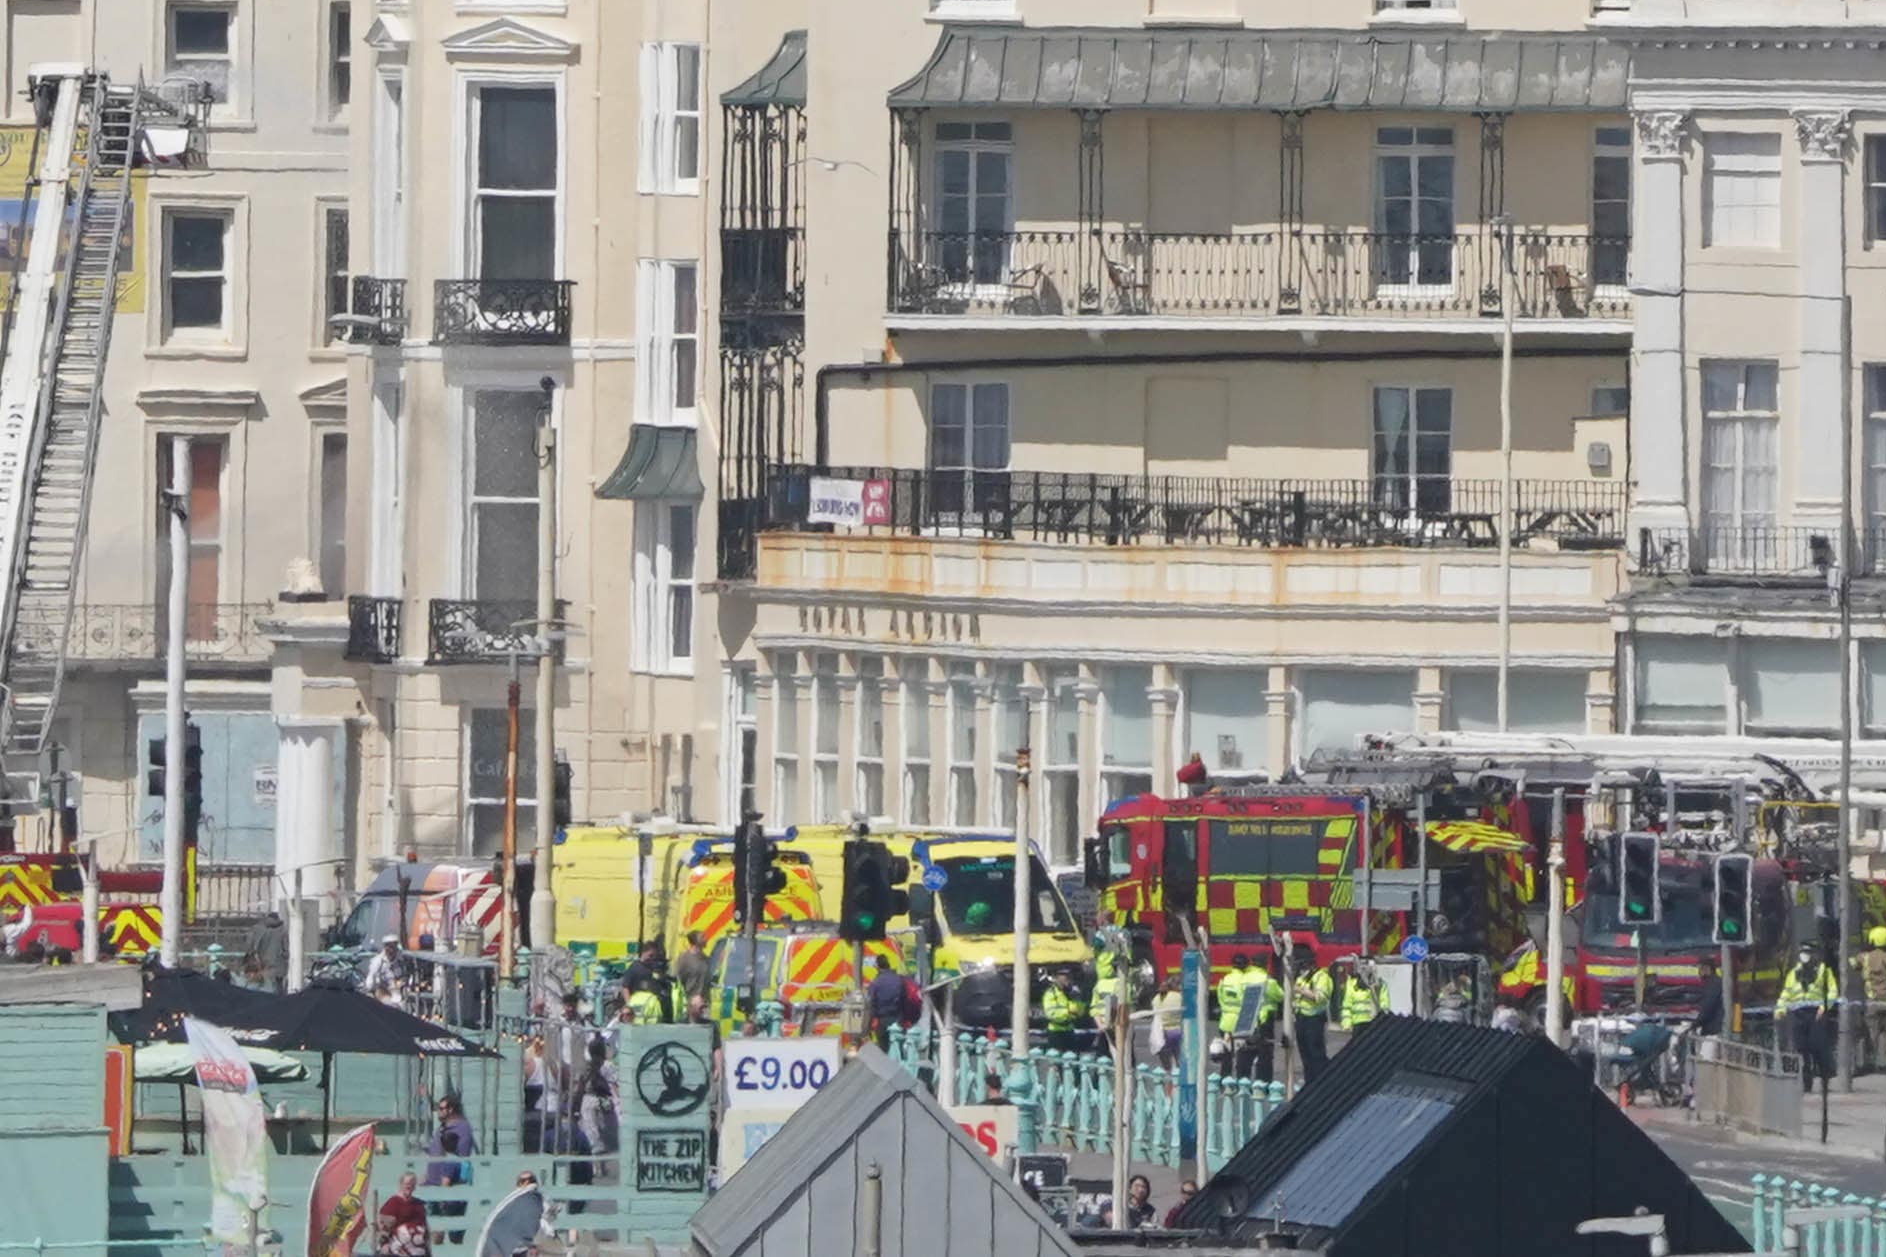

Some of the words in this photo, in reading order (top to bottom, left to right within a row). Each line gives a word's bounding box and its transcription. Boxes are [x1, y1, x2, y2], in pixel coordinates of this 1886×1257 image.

[734, 1055, 830, 1091] £9.00
[642, 1138, 668, 1157] THE
[675, 1138, 701, 1158] ZIP
[639, 1162, 701, 1183] KITCHEN
